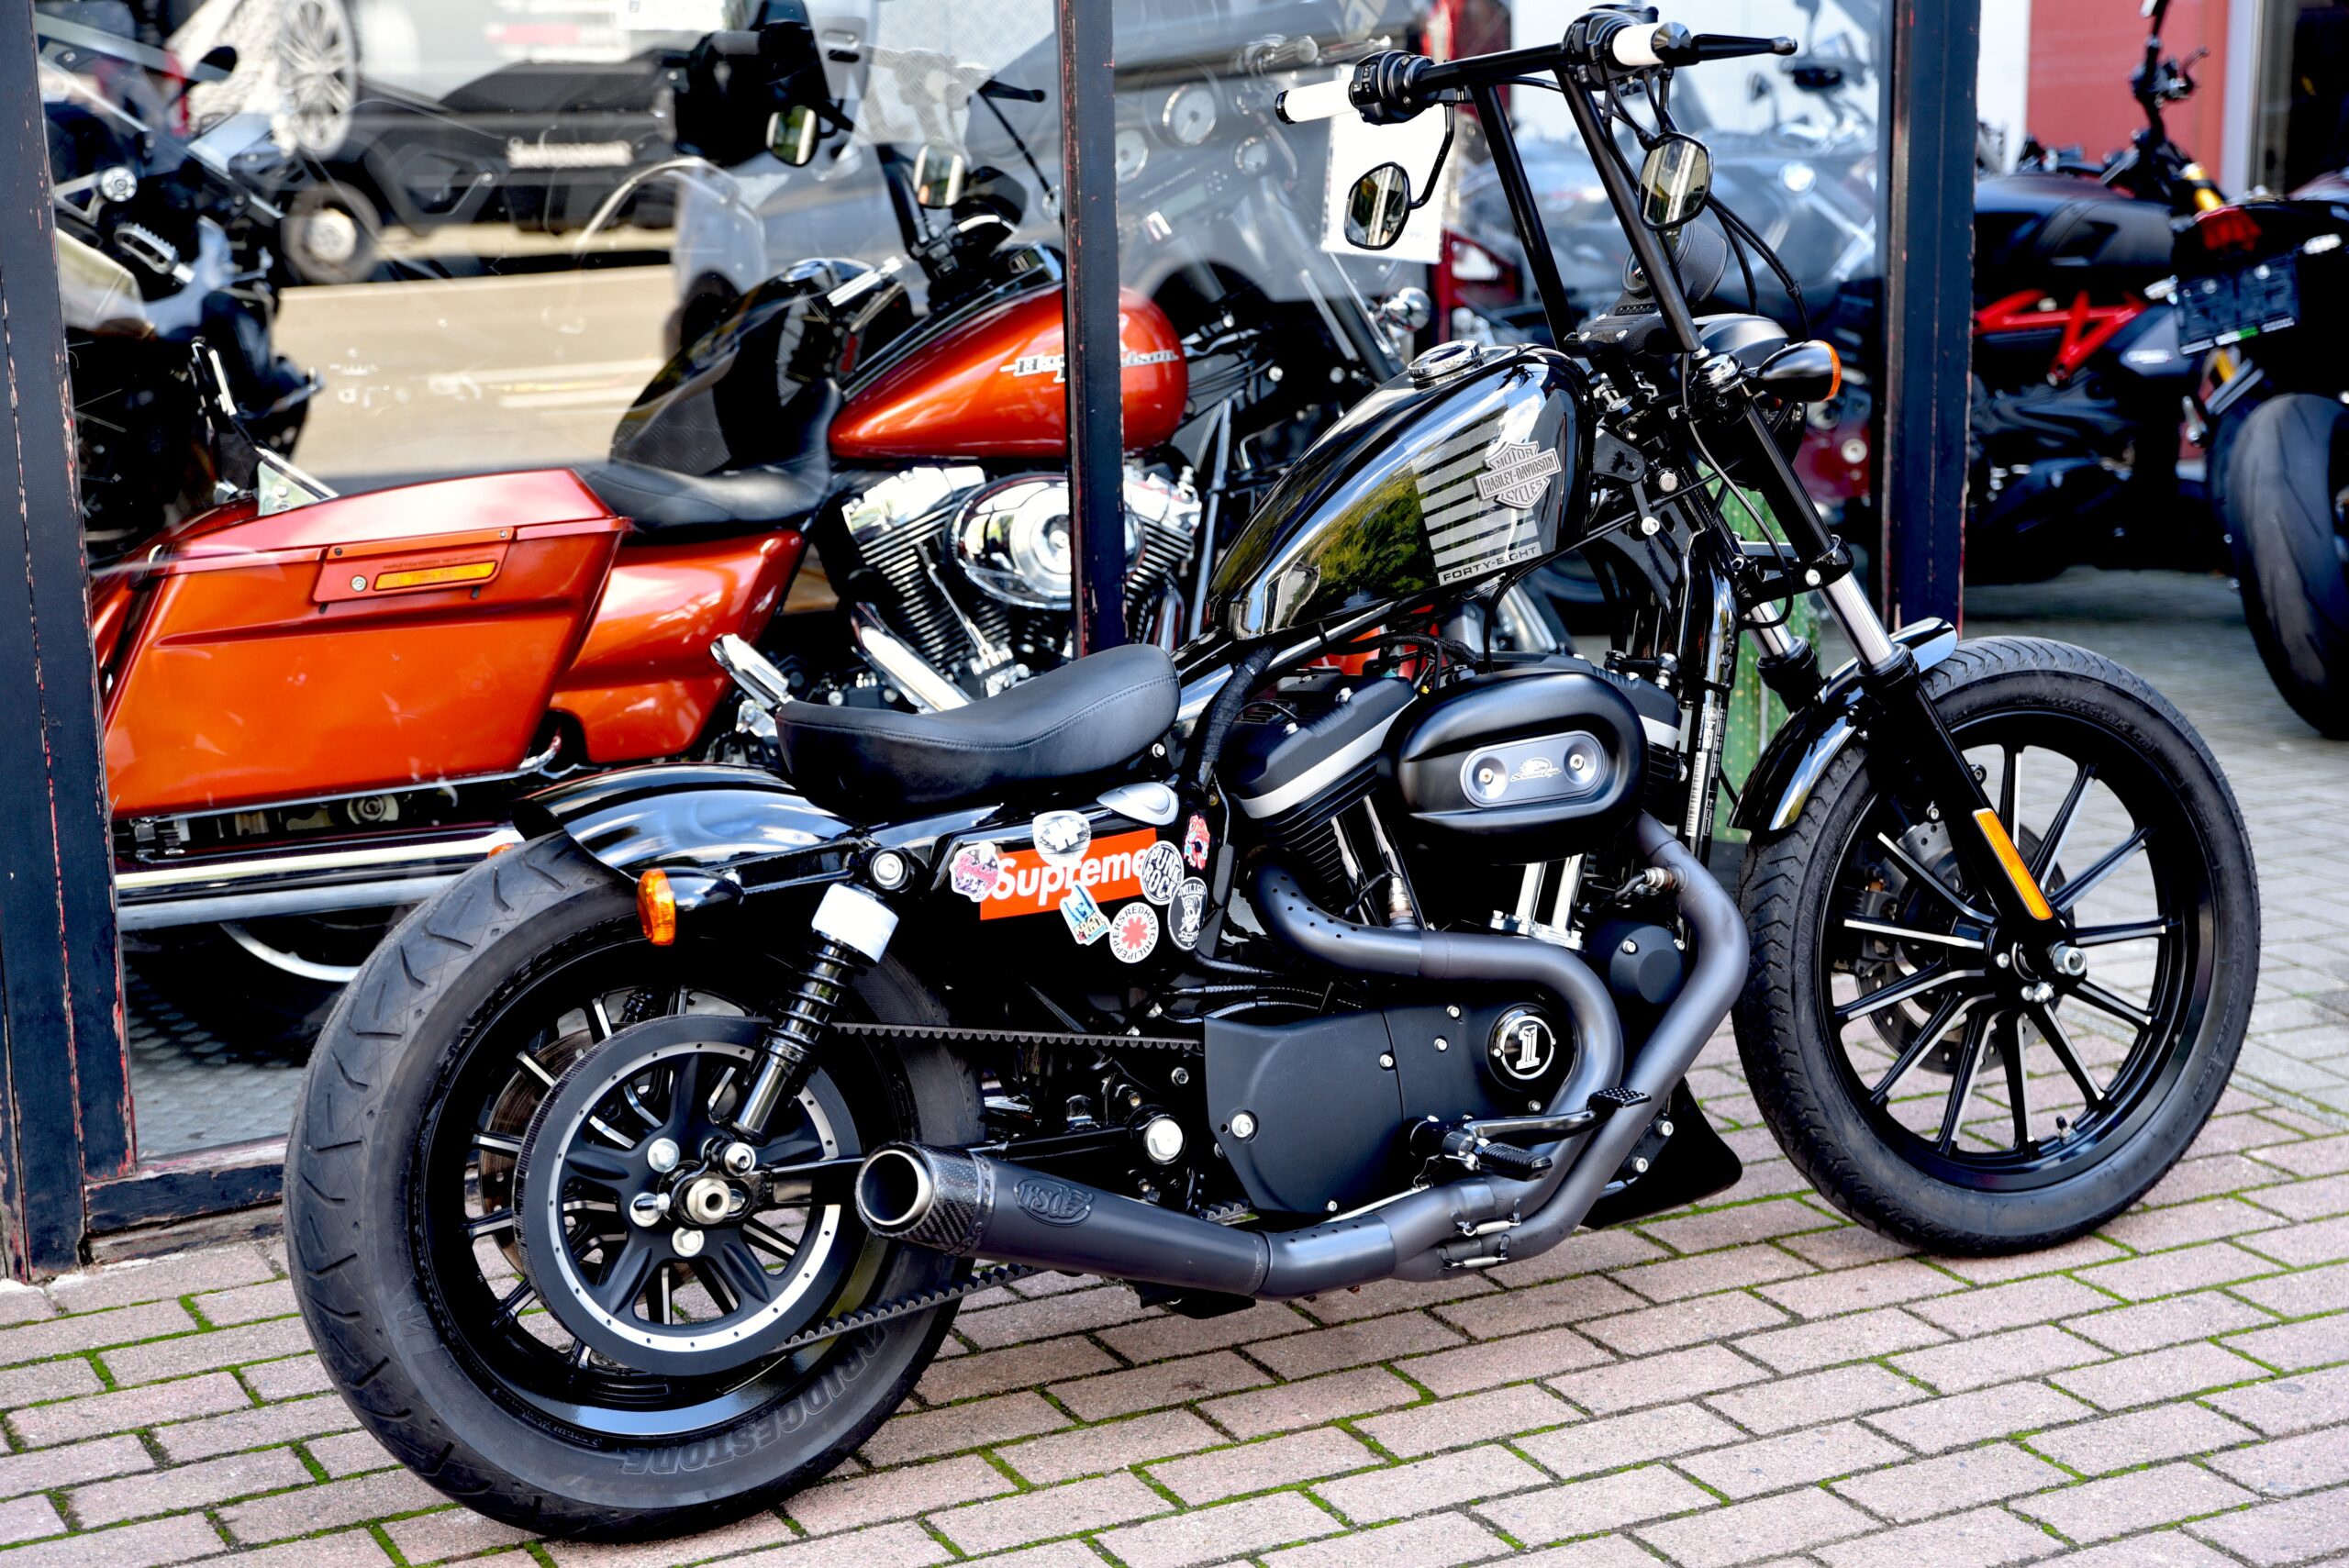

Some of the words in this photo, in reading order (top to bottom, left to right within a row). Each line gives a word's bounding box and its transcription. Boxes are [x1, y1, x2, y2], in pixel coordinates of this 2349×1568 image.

[1483, 455, 1555, 494] HARLEY-DAVIDSON
[1497, 447, 1534, 469] MOTOR
[1505, 478, 1543, 503] CYCLES
[1443, 546, 1537, 582] FORTY-EGHT
[991, 849, 1147, 906] Supreme
[1143, 864, 1177, 898] ROCK
[1149, 846, 1181, 883] PUNK
